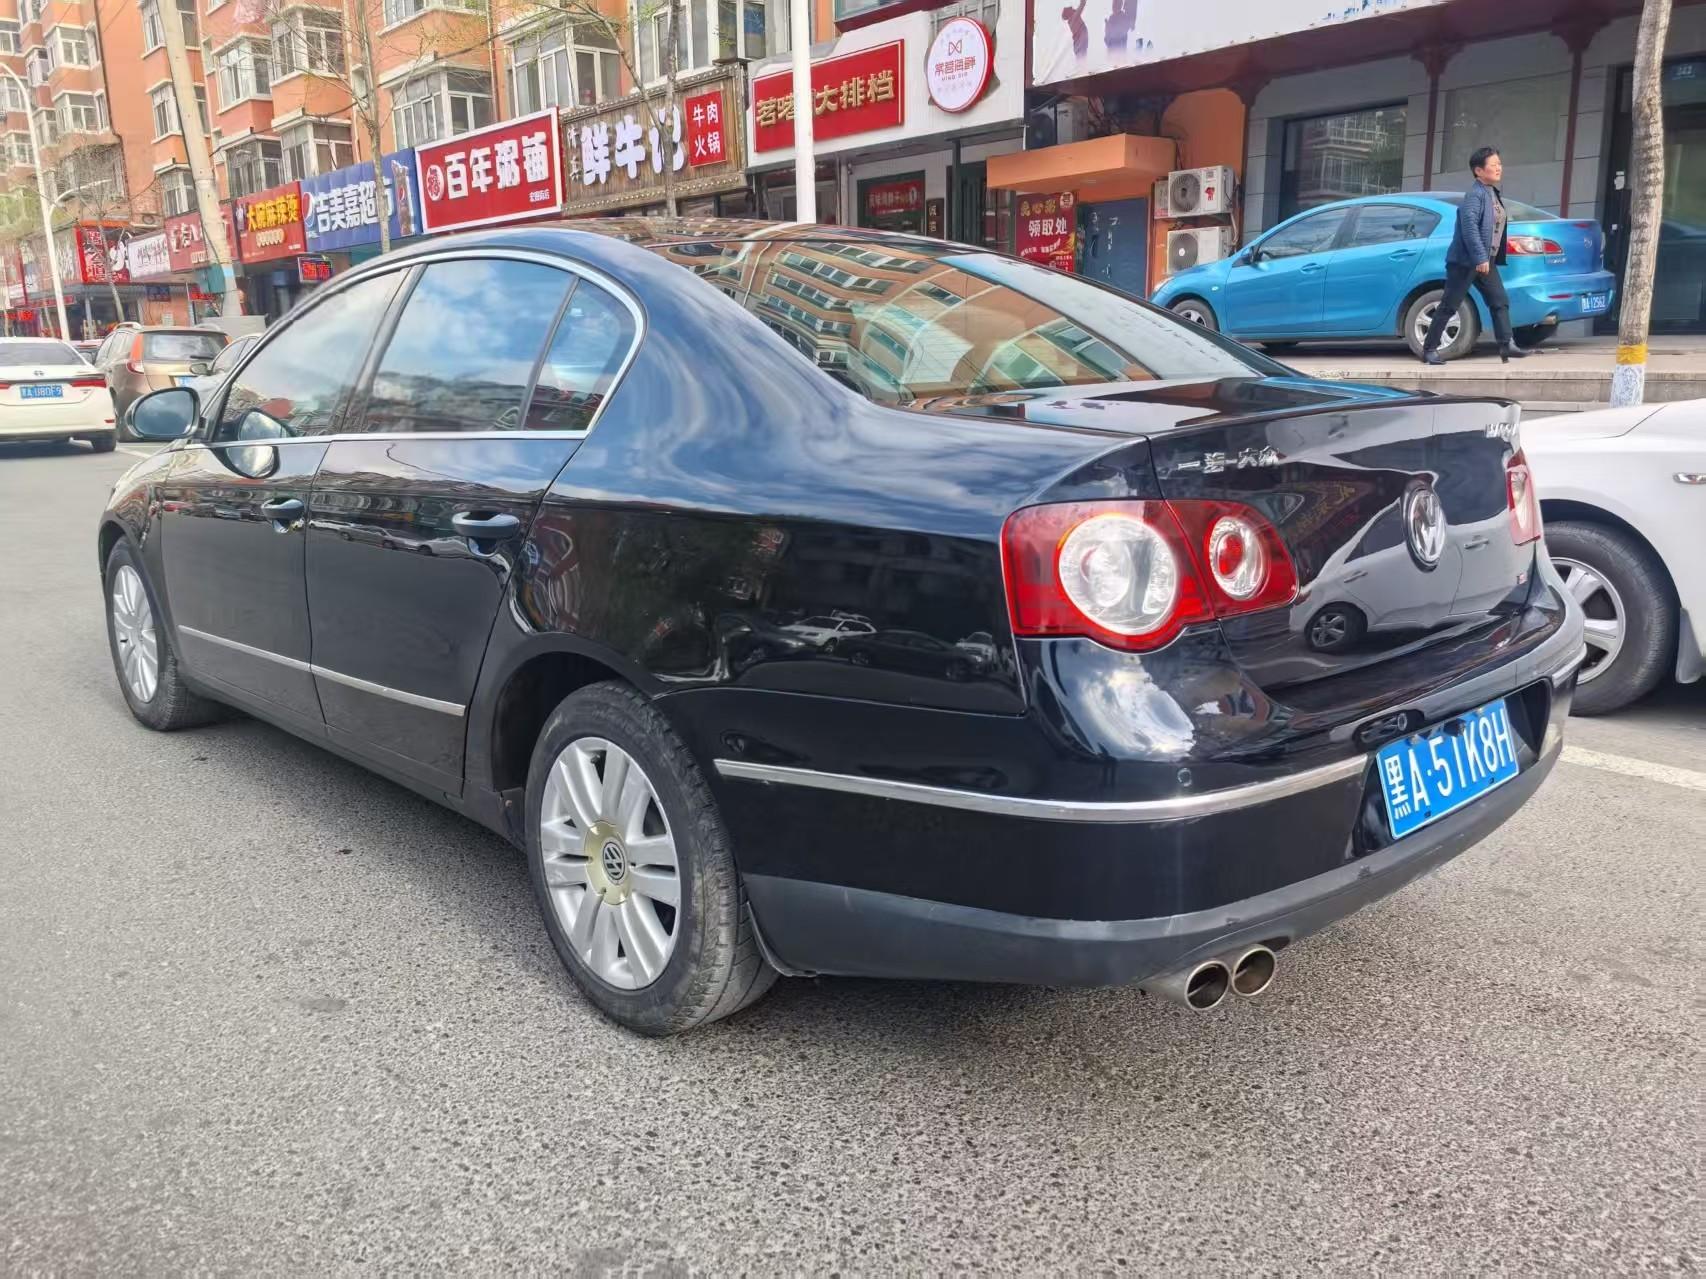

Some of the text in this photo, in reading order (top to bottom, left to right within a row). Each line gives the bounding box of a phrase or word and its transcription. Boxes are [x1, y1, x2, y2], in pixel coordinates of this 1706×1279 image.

[692, 102, 718, 127] 牛肉
[695, 131, 721, 158] 火锅
[444, 131, 549, 200] 百年粥铺
[1028, 217, 1068, 238] 领取处
